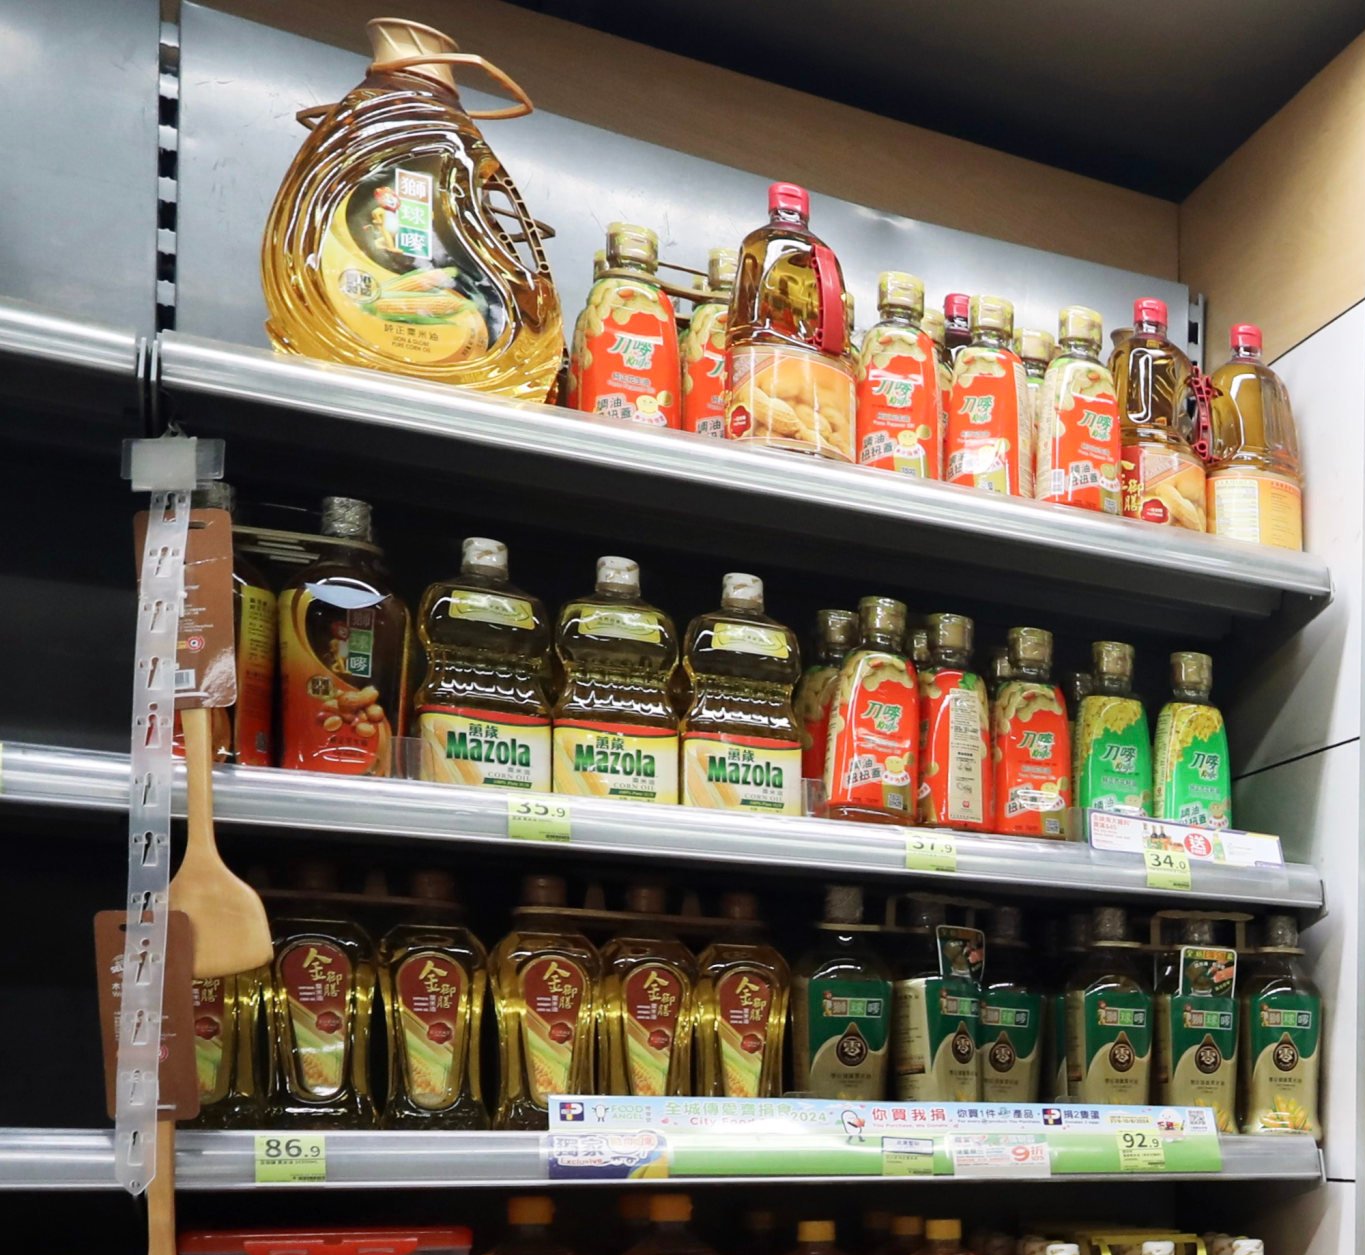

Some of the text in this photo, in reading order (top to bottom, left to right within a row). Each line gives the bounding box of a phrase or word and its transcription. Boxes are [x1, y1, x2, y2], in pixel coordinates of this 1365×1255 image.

[401, 176, 427, 254] 獅球嘜
[609, 336, 655, 357] 刀嘜
[866, 701, 903, 721] 刀嘜
[468, 722, 499, 740] 萬歲
[1018, 732, 1055, 750] 刀嘜
[446, 737, 531, 768] Mazola
[596, 737, 625, 753] 萬歲
[1102, 744, 1139, 763] 刀嘜
[574, 745, 656, 778] Mazola
[727, 748, 756, 764] 萬歲
[707, 756, 784, 789] Mazola
[1150, 853, 1187, 871] 34.0
[303, 946, 344, 999] 金御膳
[418, 961, 459, 1010] 金御膳
[542, 961, 579, 1010] 金御膳
[643, 971, 677, 1018] 金御膳
[735, 976, 768, 1022] 金御膳
[871, 1107, 947, 1123] 你買我捐
[957, 1107, 998, 1122] 你買1件
[1013, 1108, 1038, 1120] 產品
[265, 1138, 321, 1160] 86.9
[1123, 1132, 1160, 1150] 92.9
